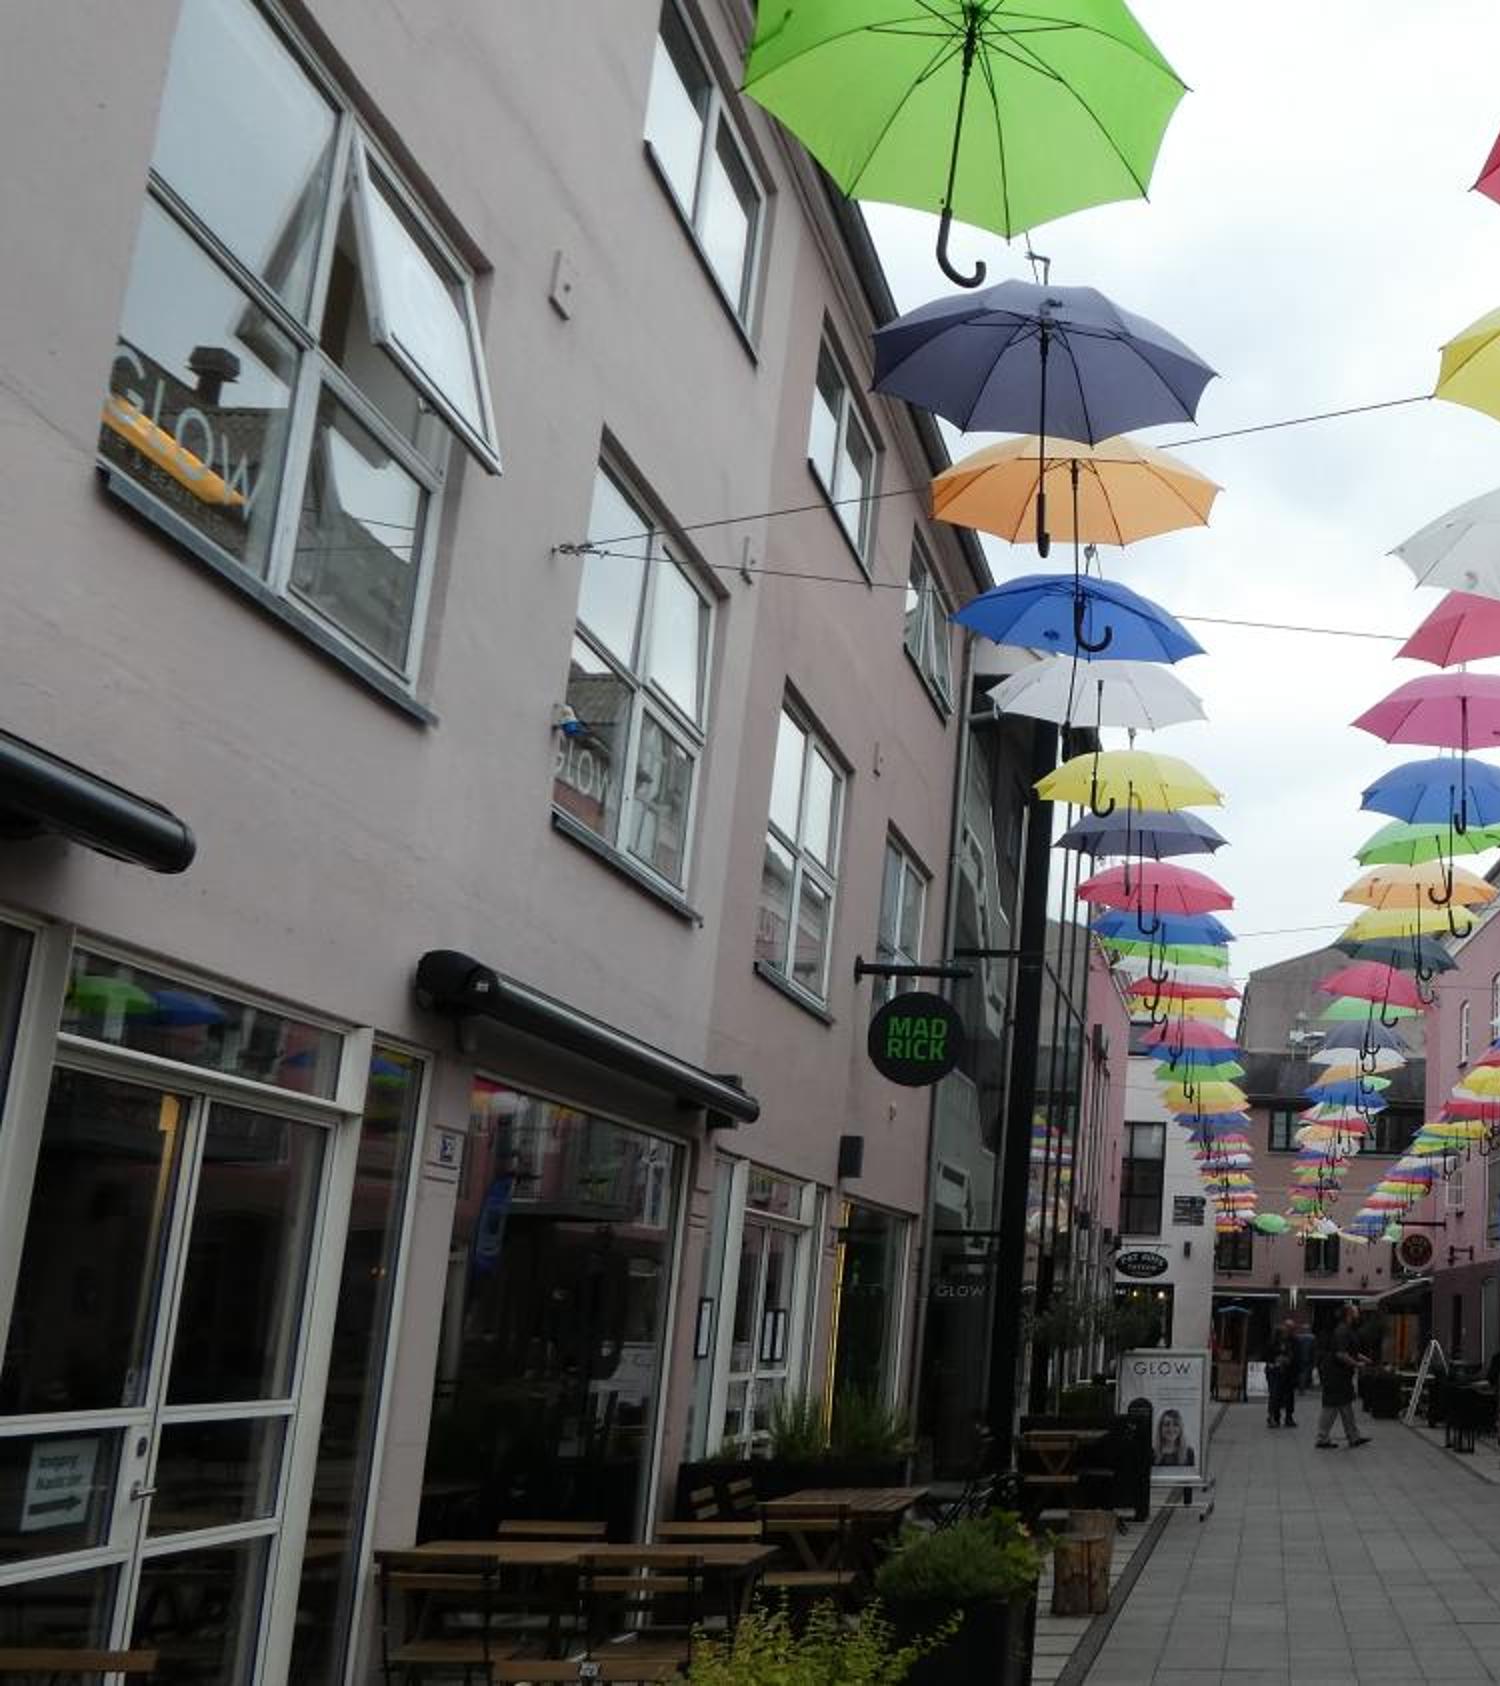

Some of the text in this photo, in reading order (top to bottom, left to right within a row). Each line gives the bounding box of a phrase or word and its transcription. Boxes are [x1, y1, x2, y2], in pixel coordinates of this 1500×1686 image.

[106, 346, 264, 520] GLOW
[888, 1016, 948, 1039] MAD
[887, 1039, 945, 1060] RICK
[935, 1284, 986, 1297] GLOW
[1133, 1361, 1192, 1376] GLOW
